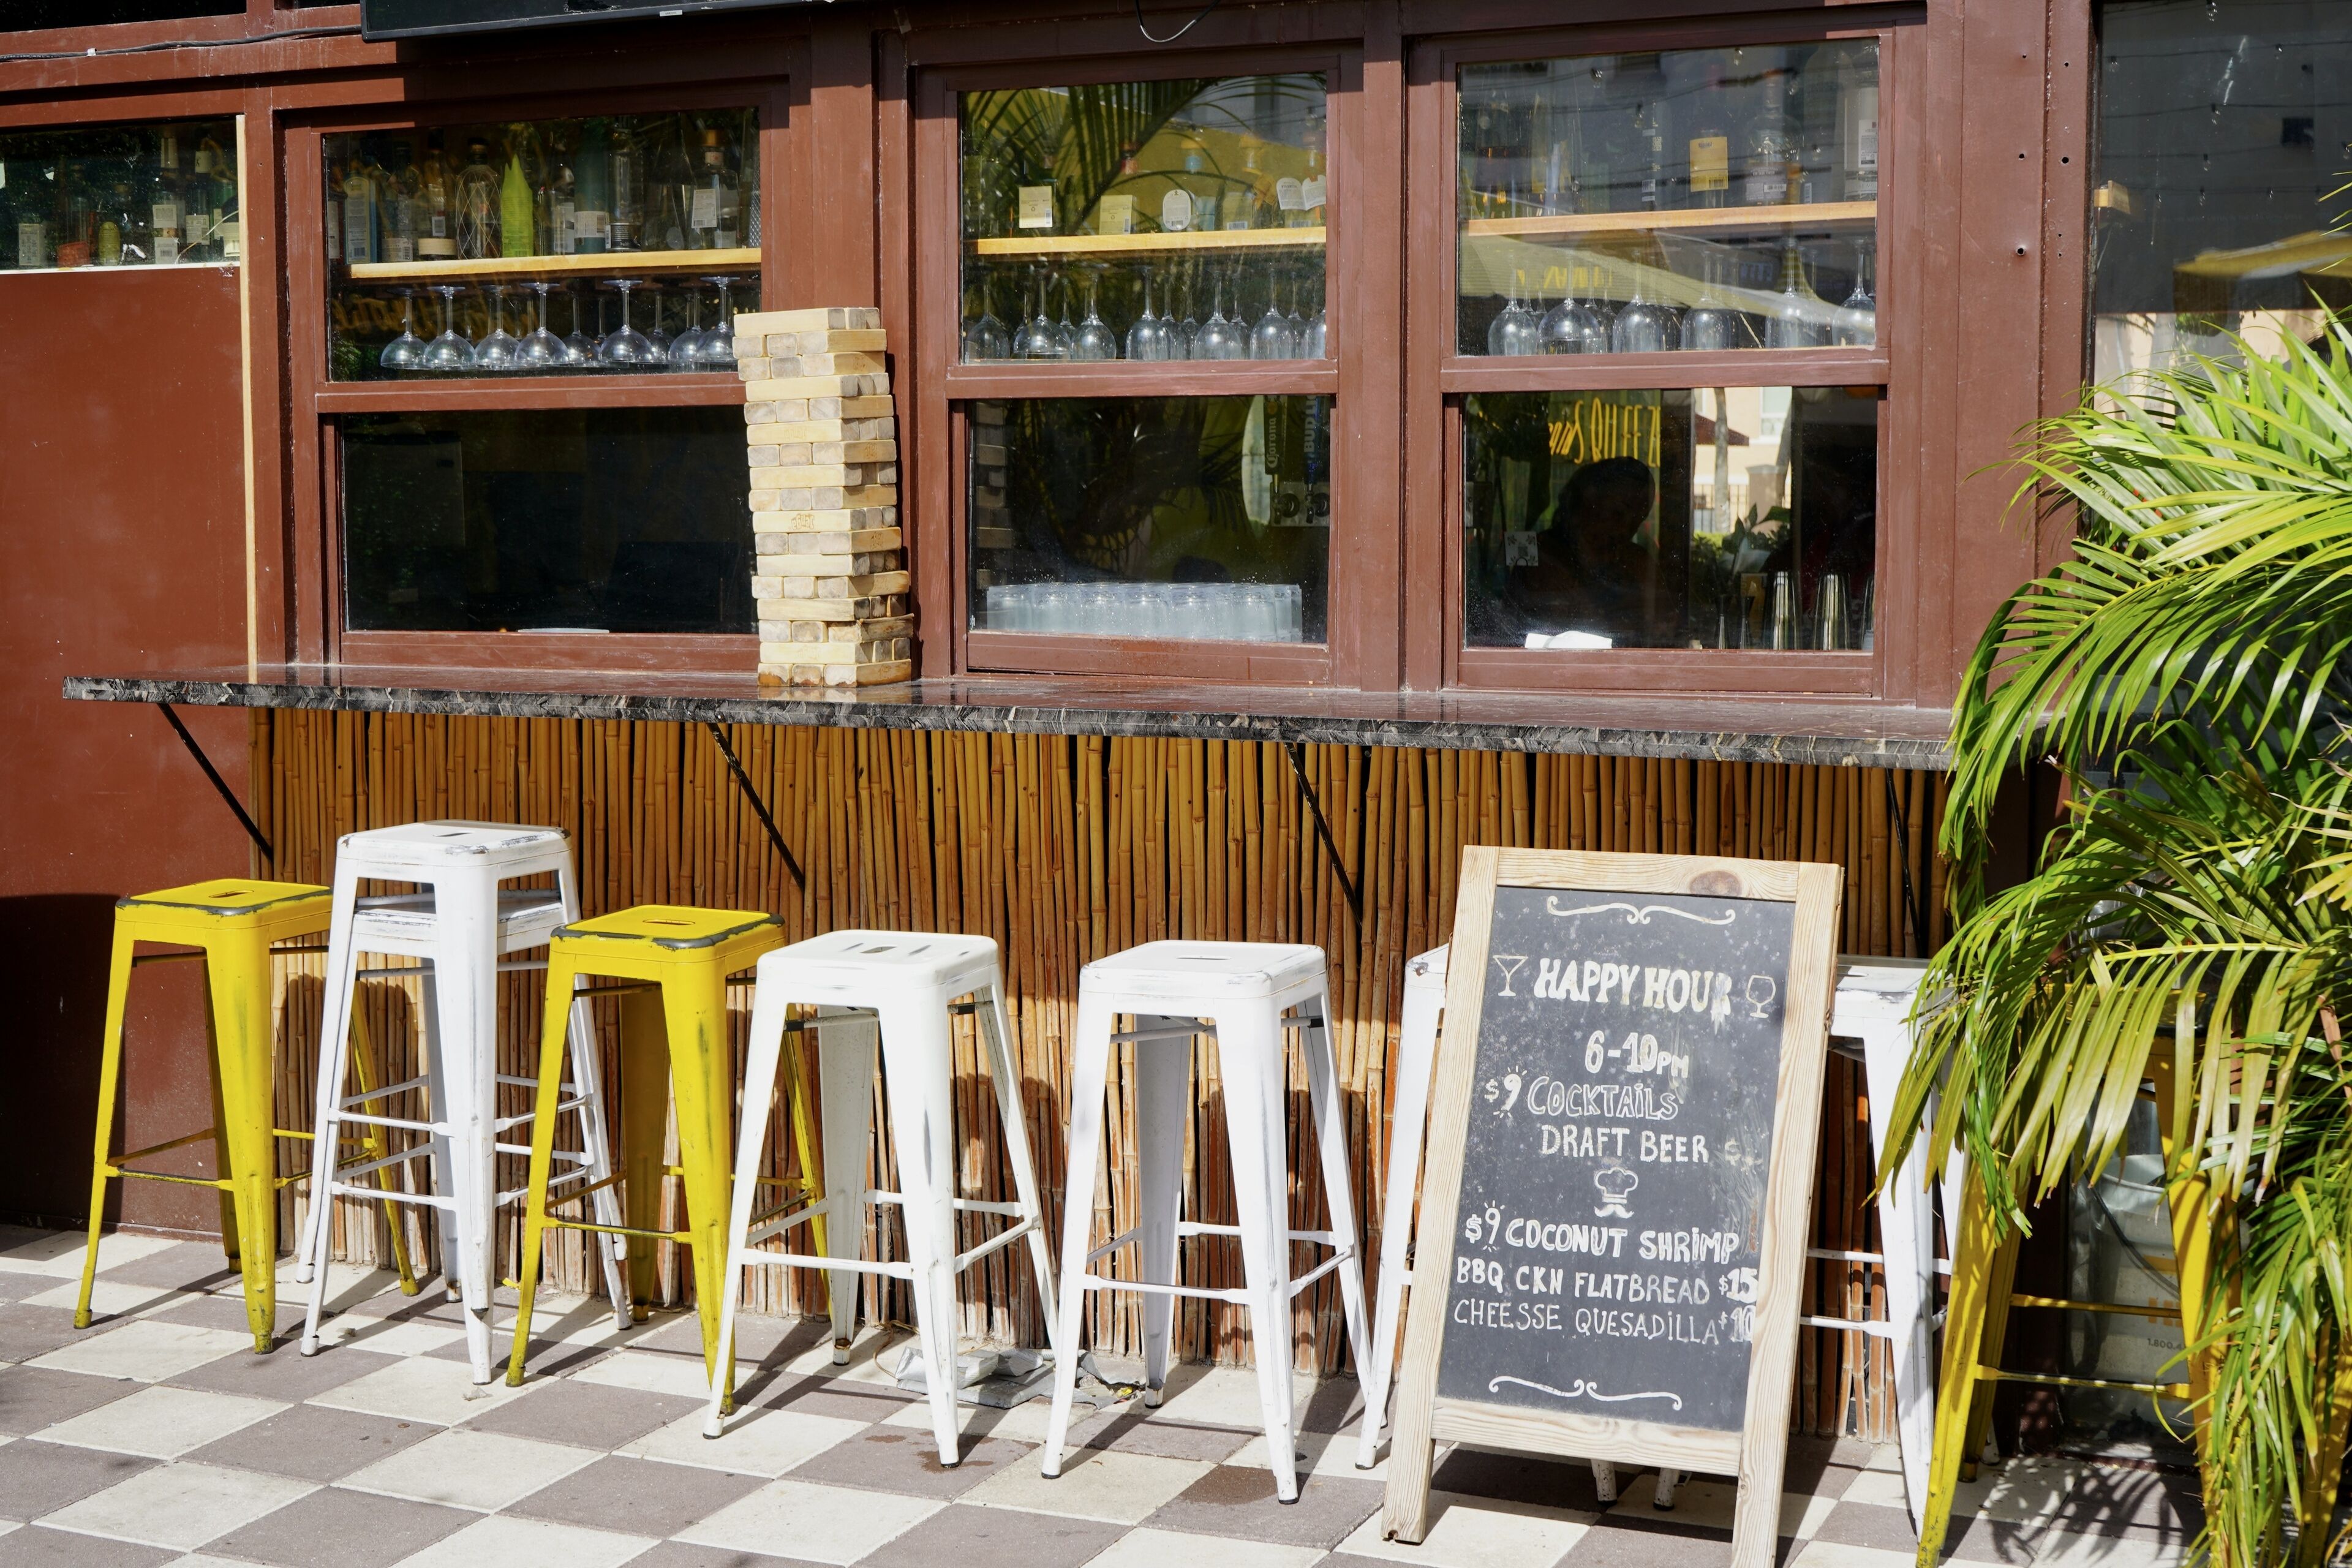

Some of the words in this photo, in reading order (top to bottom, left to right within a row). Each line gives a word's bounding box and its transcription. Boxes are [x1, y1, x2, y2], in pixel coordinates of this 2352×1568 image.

[1267, 418, 1279, 468] Corona
[1303, 417, 1316, 452] BUD
[1534, 957, 1640, 1005] HAPPY
[1643, 967, 1732, 1016] HOUR
[1484, 1073, 1522, 1111] $9
[1541, 1125, 1630, 1158] DRAFT
[1640, 1131, 1709, 1163] BEER
[1465, 1207, 1501, 1244] $9
[1506, 1218, 1628, 1257] COCONUT
[1456, 1257, 1504, 1294] BBQ
[1515, 1265, 1564, 1295] CKN
[1575, 1272, 1711, 1305] FLATBREAD
[1719, 1267, 1759, 1304] $15
[1454, 1299, 1562, 1330] CHEESSE
[1718, 1305, 1757, 1344] $10
